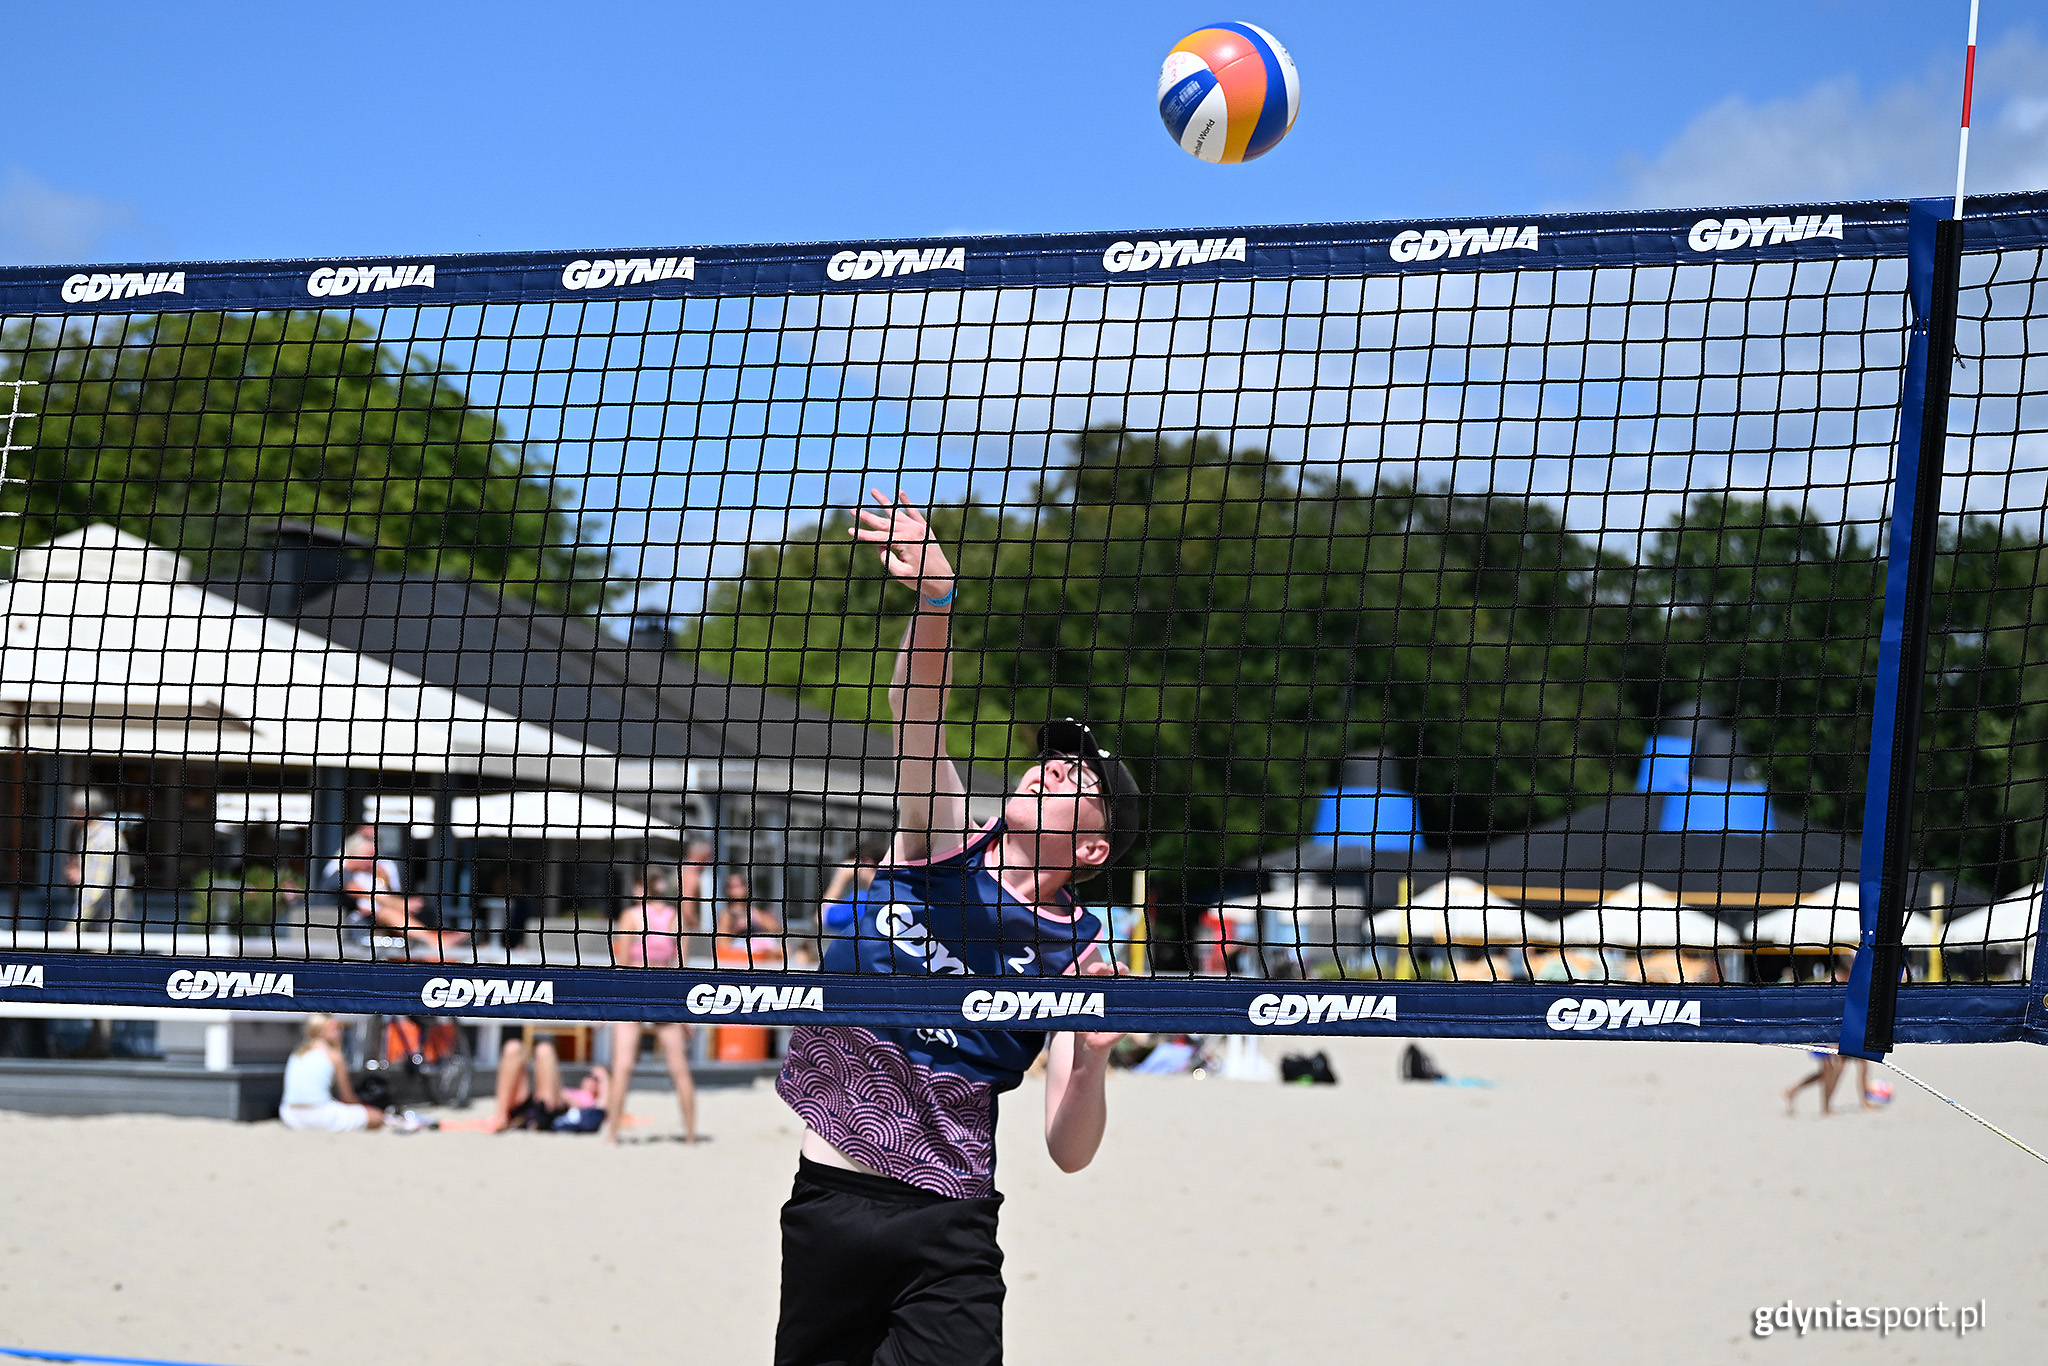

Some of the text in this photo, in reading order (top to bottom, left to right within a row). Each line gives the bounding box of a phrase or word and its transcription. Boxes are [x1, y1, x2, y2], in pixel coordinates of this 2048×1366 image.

[1198, 119, 1216, 140] World
[1389, 226, 1539, 262] GDYNIA
[1688, 215, 1844, 251] GDYNIA
[827, 248, 966, 282] GDYNIA
[1103, 238, 1247, 273] GDYNIA
[61, 271, 185, 303] GDYNIA
[307, 265, 435, 298] GDYNIA
[562, 257, 695, 291] GDYNIA
[1007, 946, 1036, 974] 2
[166, 970, 294, 1000] GDYNIA
[421, 978, 554, 1009] GDYNIA
[686, 984, 824, 1015] GDYNIA
[962, 990, 1105, 1022] GDYNIA
[1248, 994, 1397, 1026] GDYNIA
[1546, 998, 1701, 1031] GDYNIA
